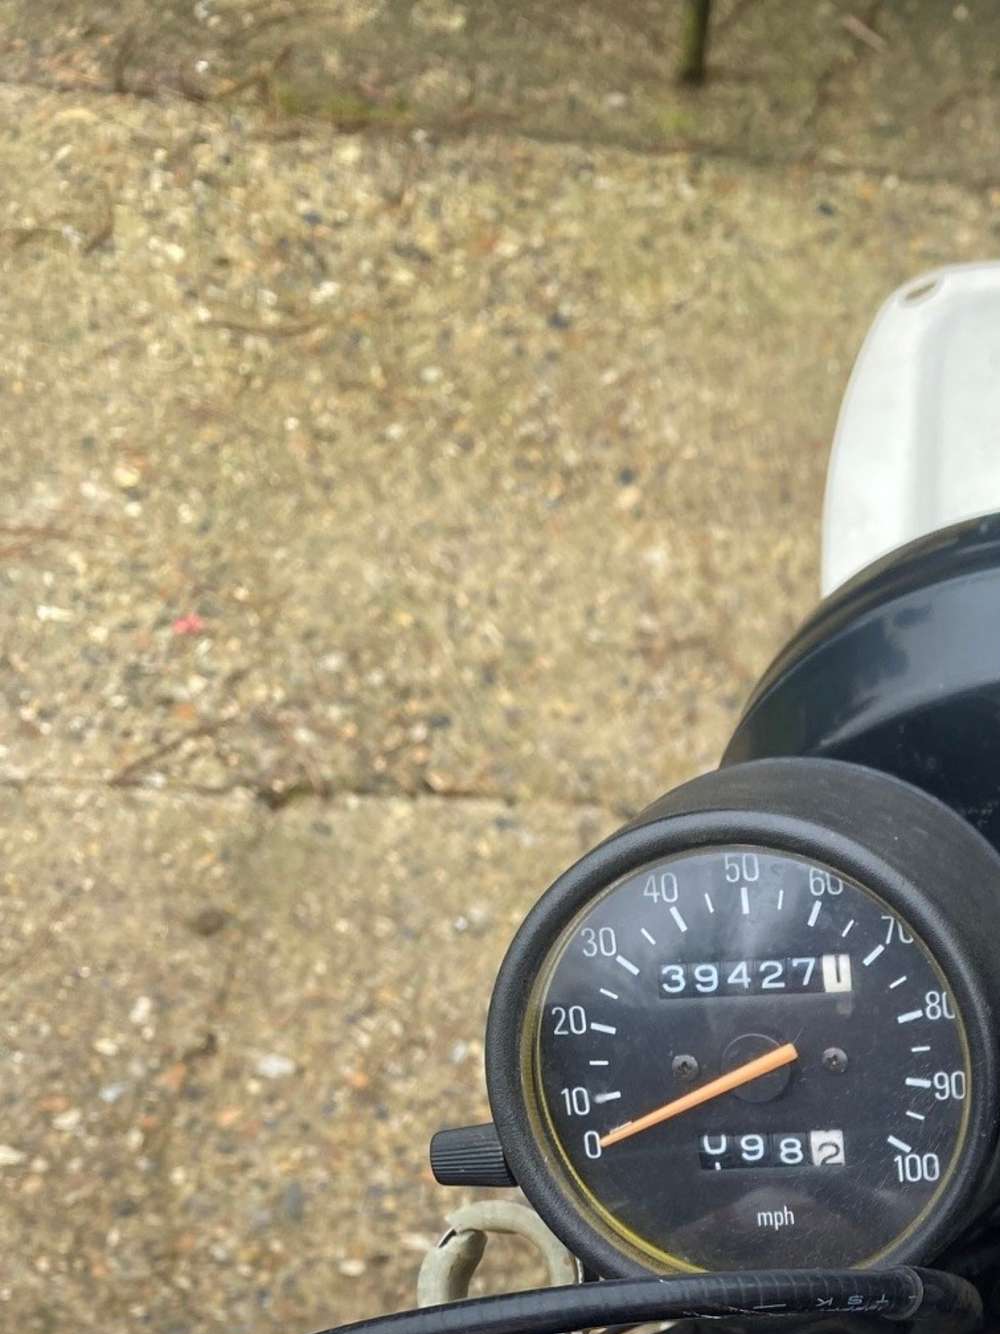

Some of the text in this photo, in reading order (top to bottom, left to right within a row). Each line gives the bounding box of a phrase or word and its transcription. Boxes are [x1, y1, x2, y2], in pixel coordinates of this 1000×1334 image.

[724, 853, 760, 882] 50
[809, 868, 844, 896] 60
[643, 872, 679, 903] 40
[580, 927, 617, 957] 30
[551, 1005, 587, 1035] 20
[925, 990, 955, 1020] 80
[933, 1070, 966, 1100] 90
[560, 1086, 591, 1116] 10
[583, 1130, 602, 1159] 0
[893, 1153, 941, 1183] 100
[756, 1205, 796, 1231] mph
